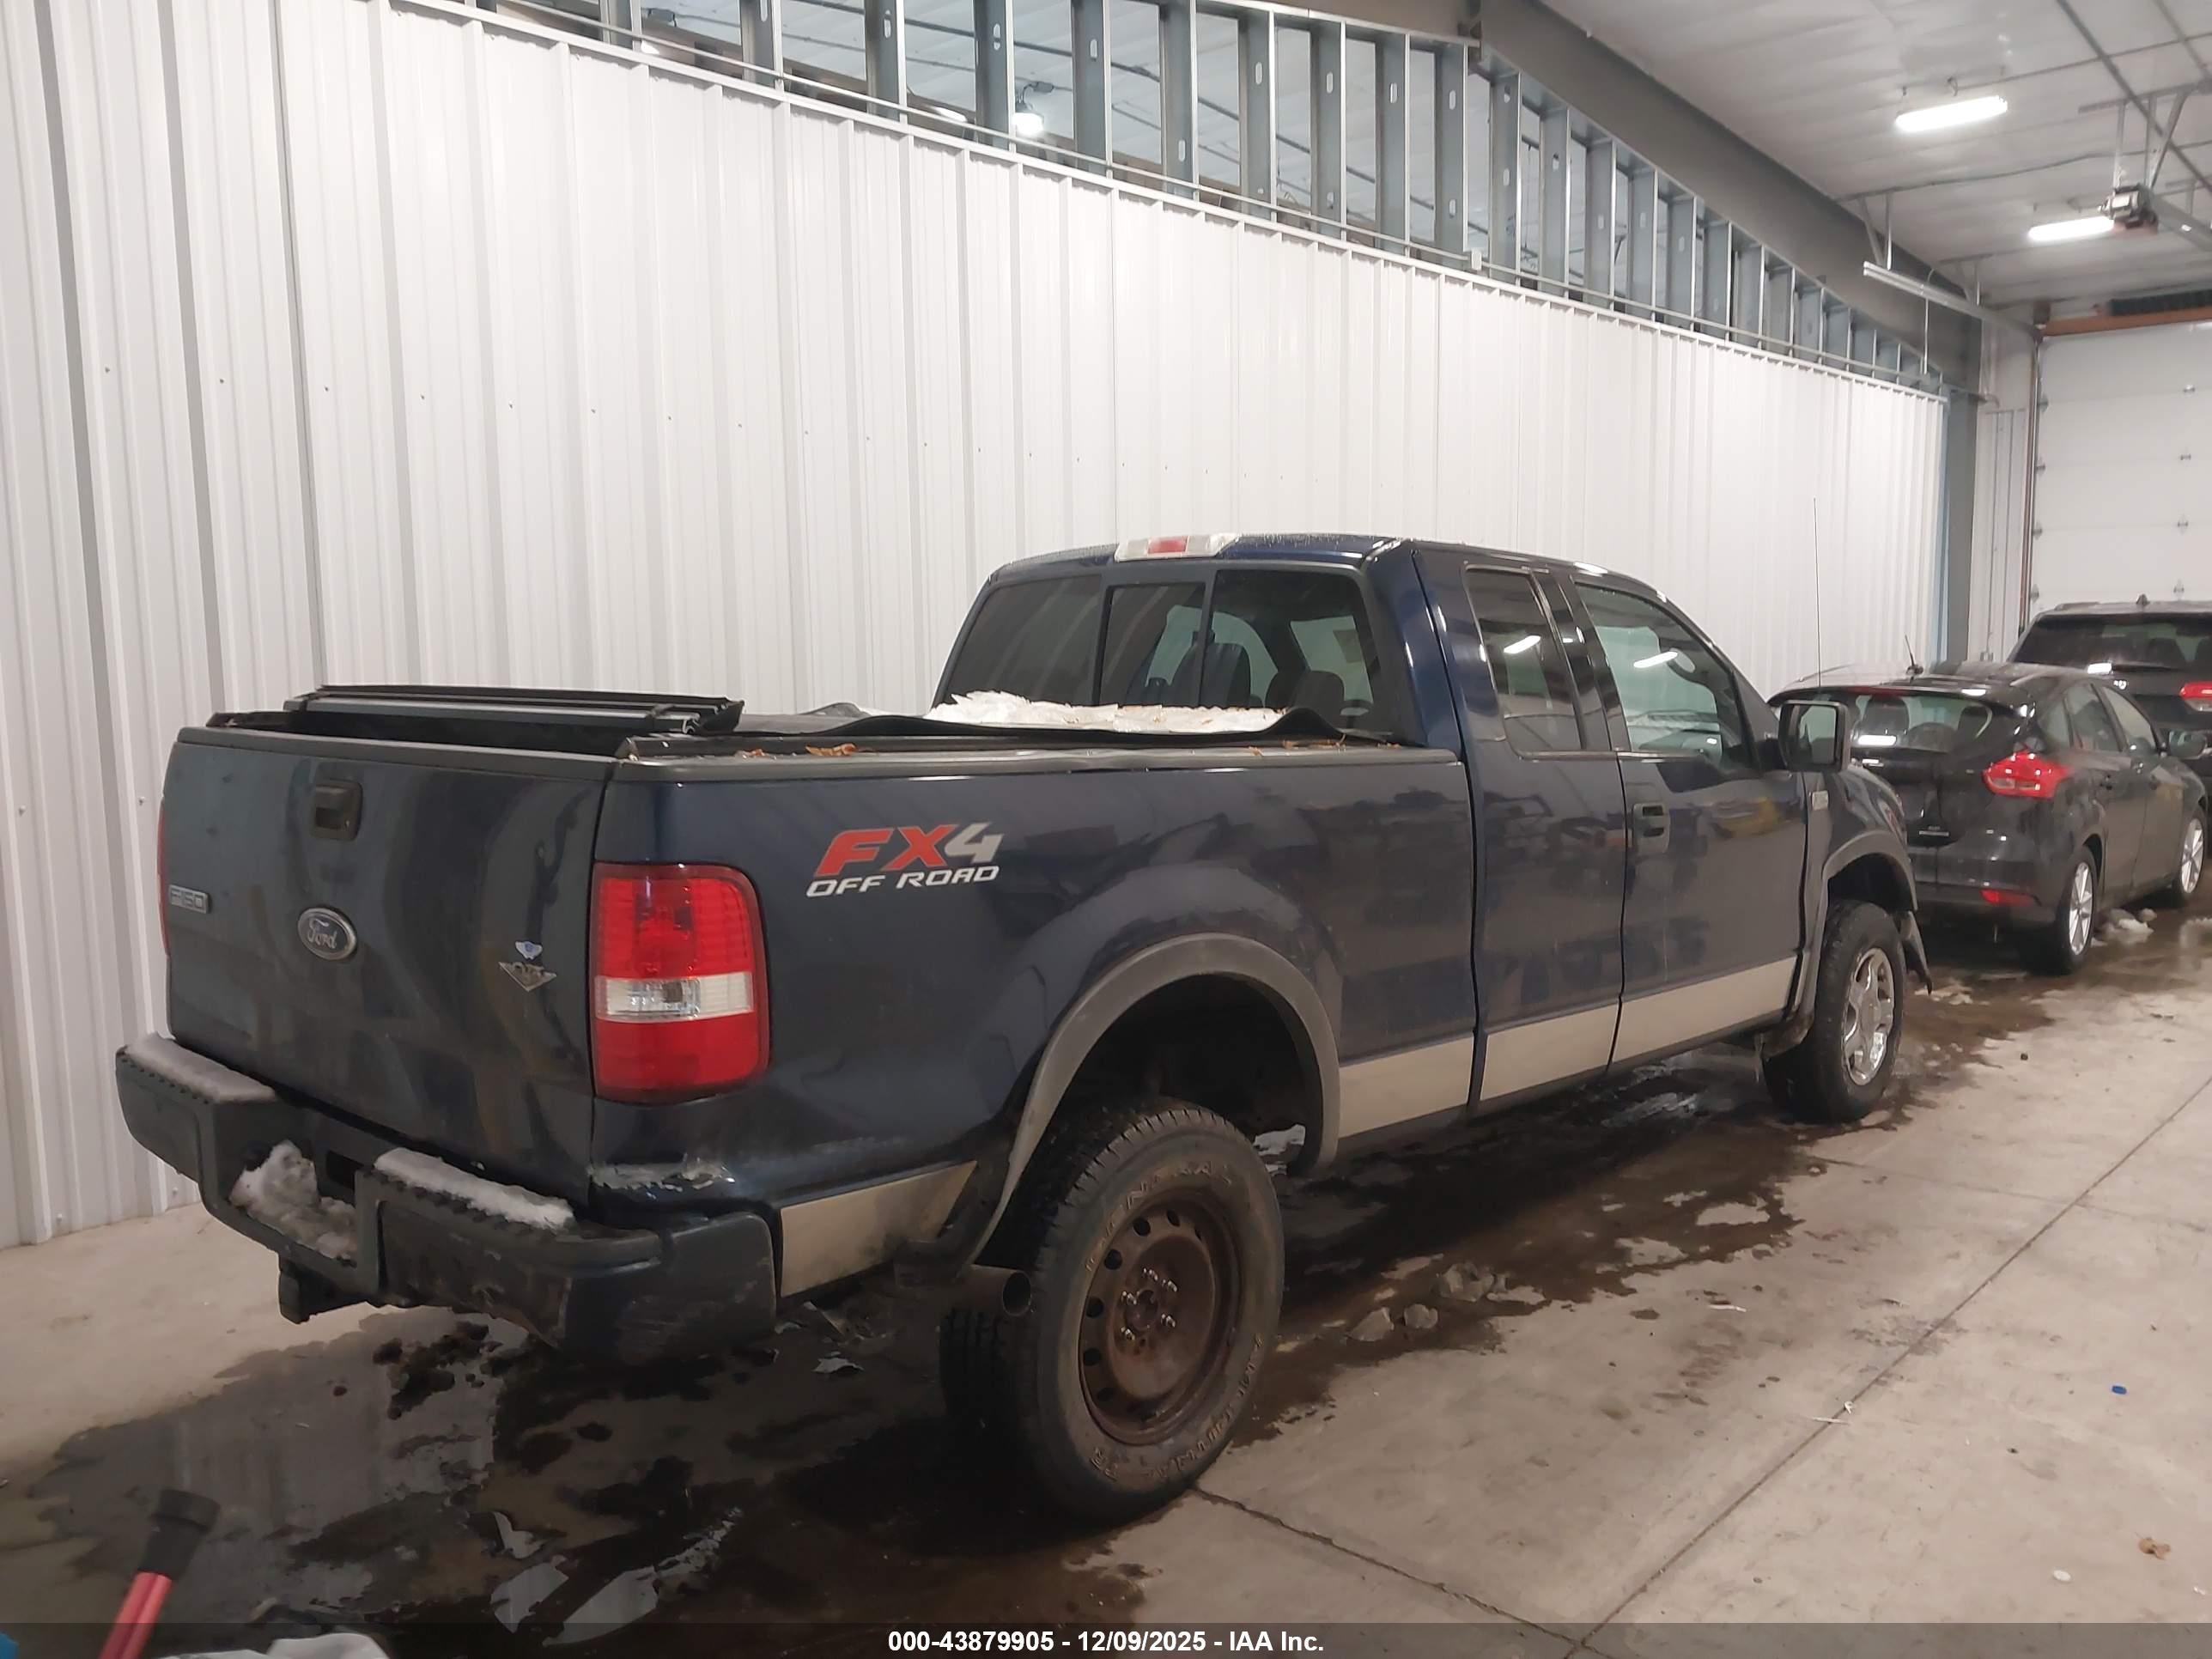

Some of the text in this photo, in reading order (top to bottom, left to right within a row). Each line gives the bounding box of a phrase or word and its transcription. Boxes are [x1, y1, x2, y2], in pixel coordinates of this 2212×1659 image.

[814, 822, 1005, 878] FX4
[806, 865, 1000, 897] OFF ROAD
[307, 917, 338, 949] Ford
